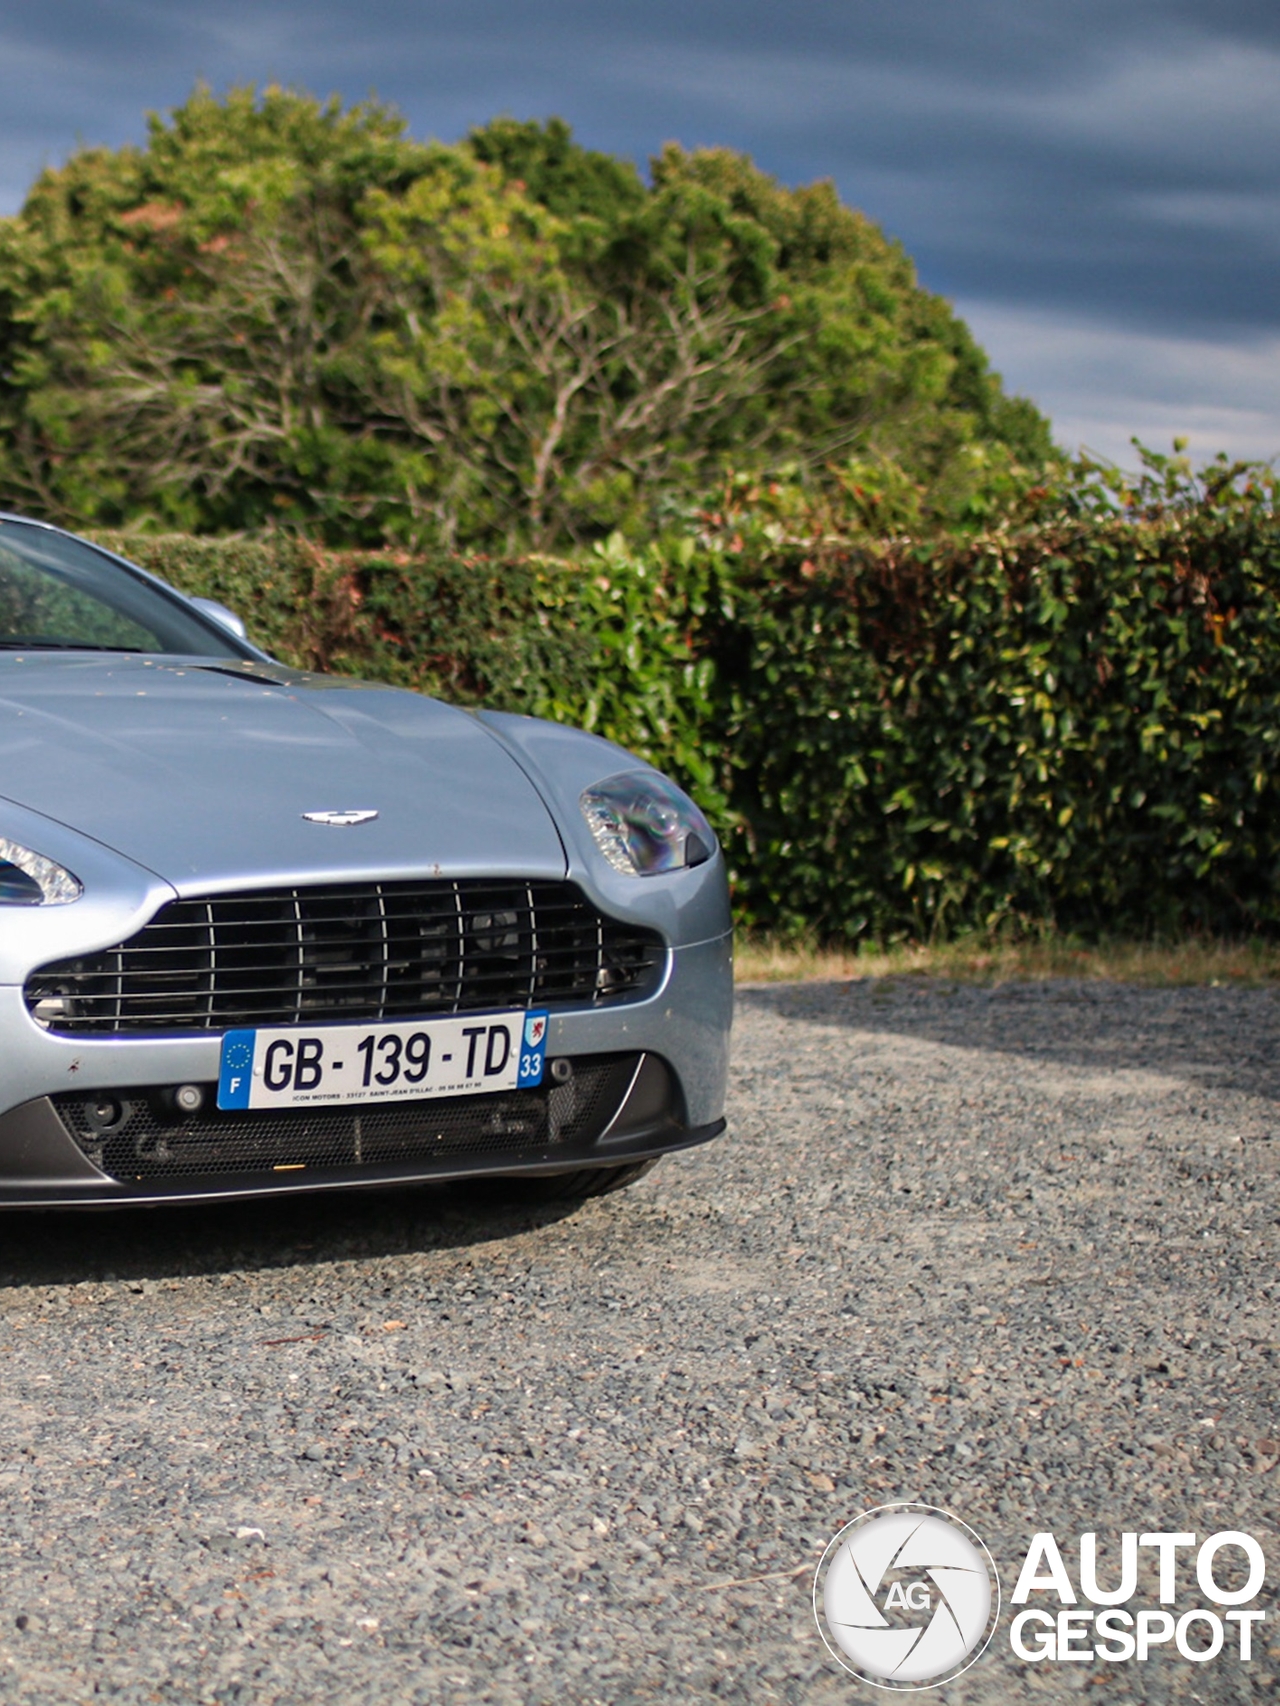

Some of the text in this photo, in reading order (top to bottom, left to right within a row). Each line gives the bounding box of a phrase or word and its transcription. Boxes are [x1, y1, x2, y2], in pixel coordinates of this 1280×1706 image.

[520, 1054, 542, 1078] 33
[230, 1078, 240, 1094] F
[312, 1093, 340, 1101] MOTORS
